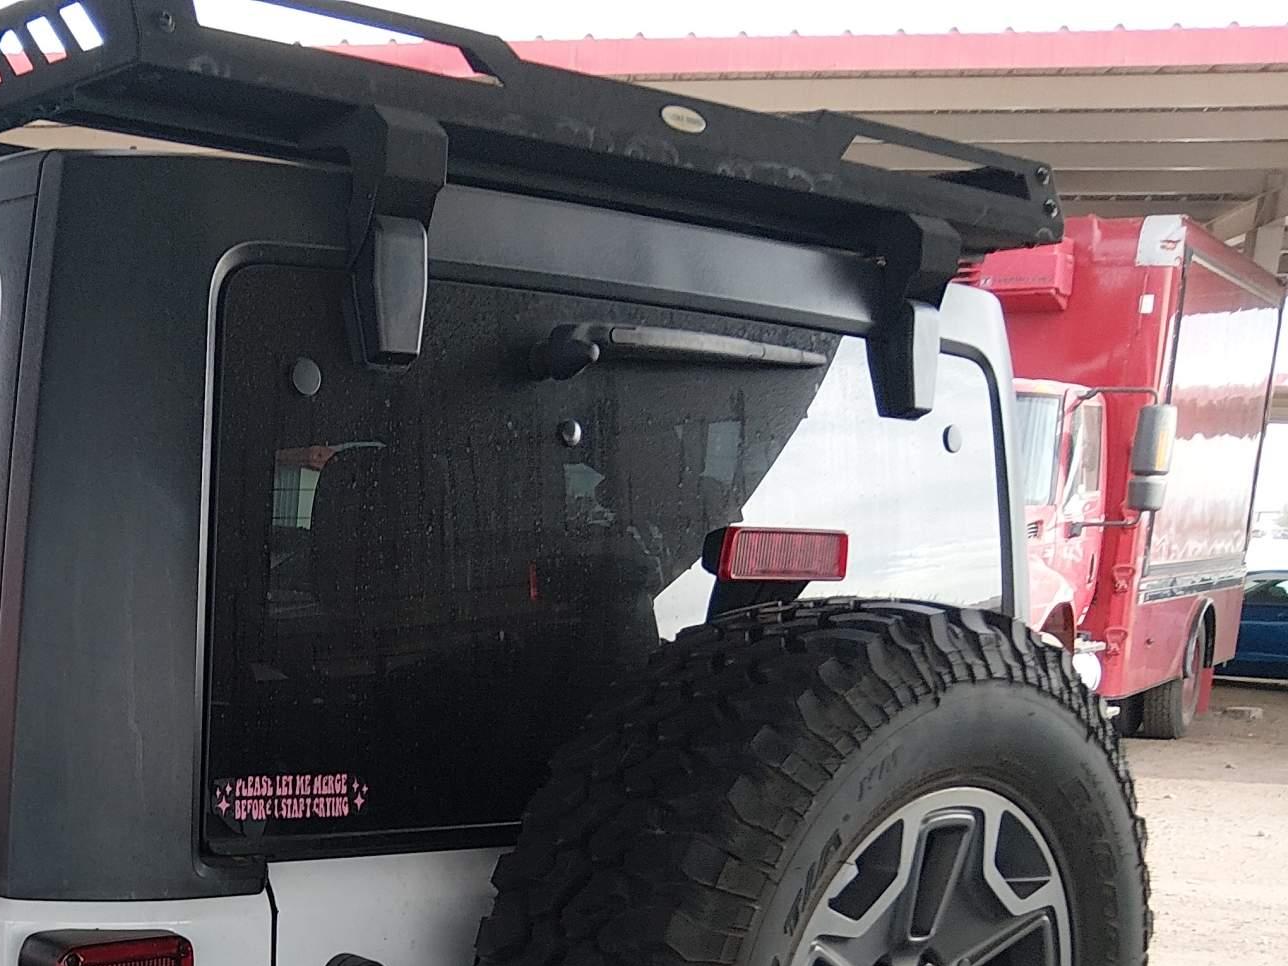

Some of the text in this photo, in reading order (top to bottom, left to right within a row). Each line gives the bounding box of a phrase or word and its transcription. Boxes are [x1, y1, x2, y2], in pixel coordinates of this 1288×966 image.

[235, 773, 348, 797] PLEASE LET ME MERGE
[234, 796, 349, 820] BEFORE I START CRYING
